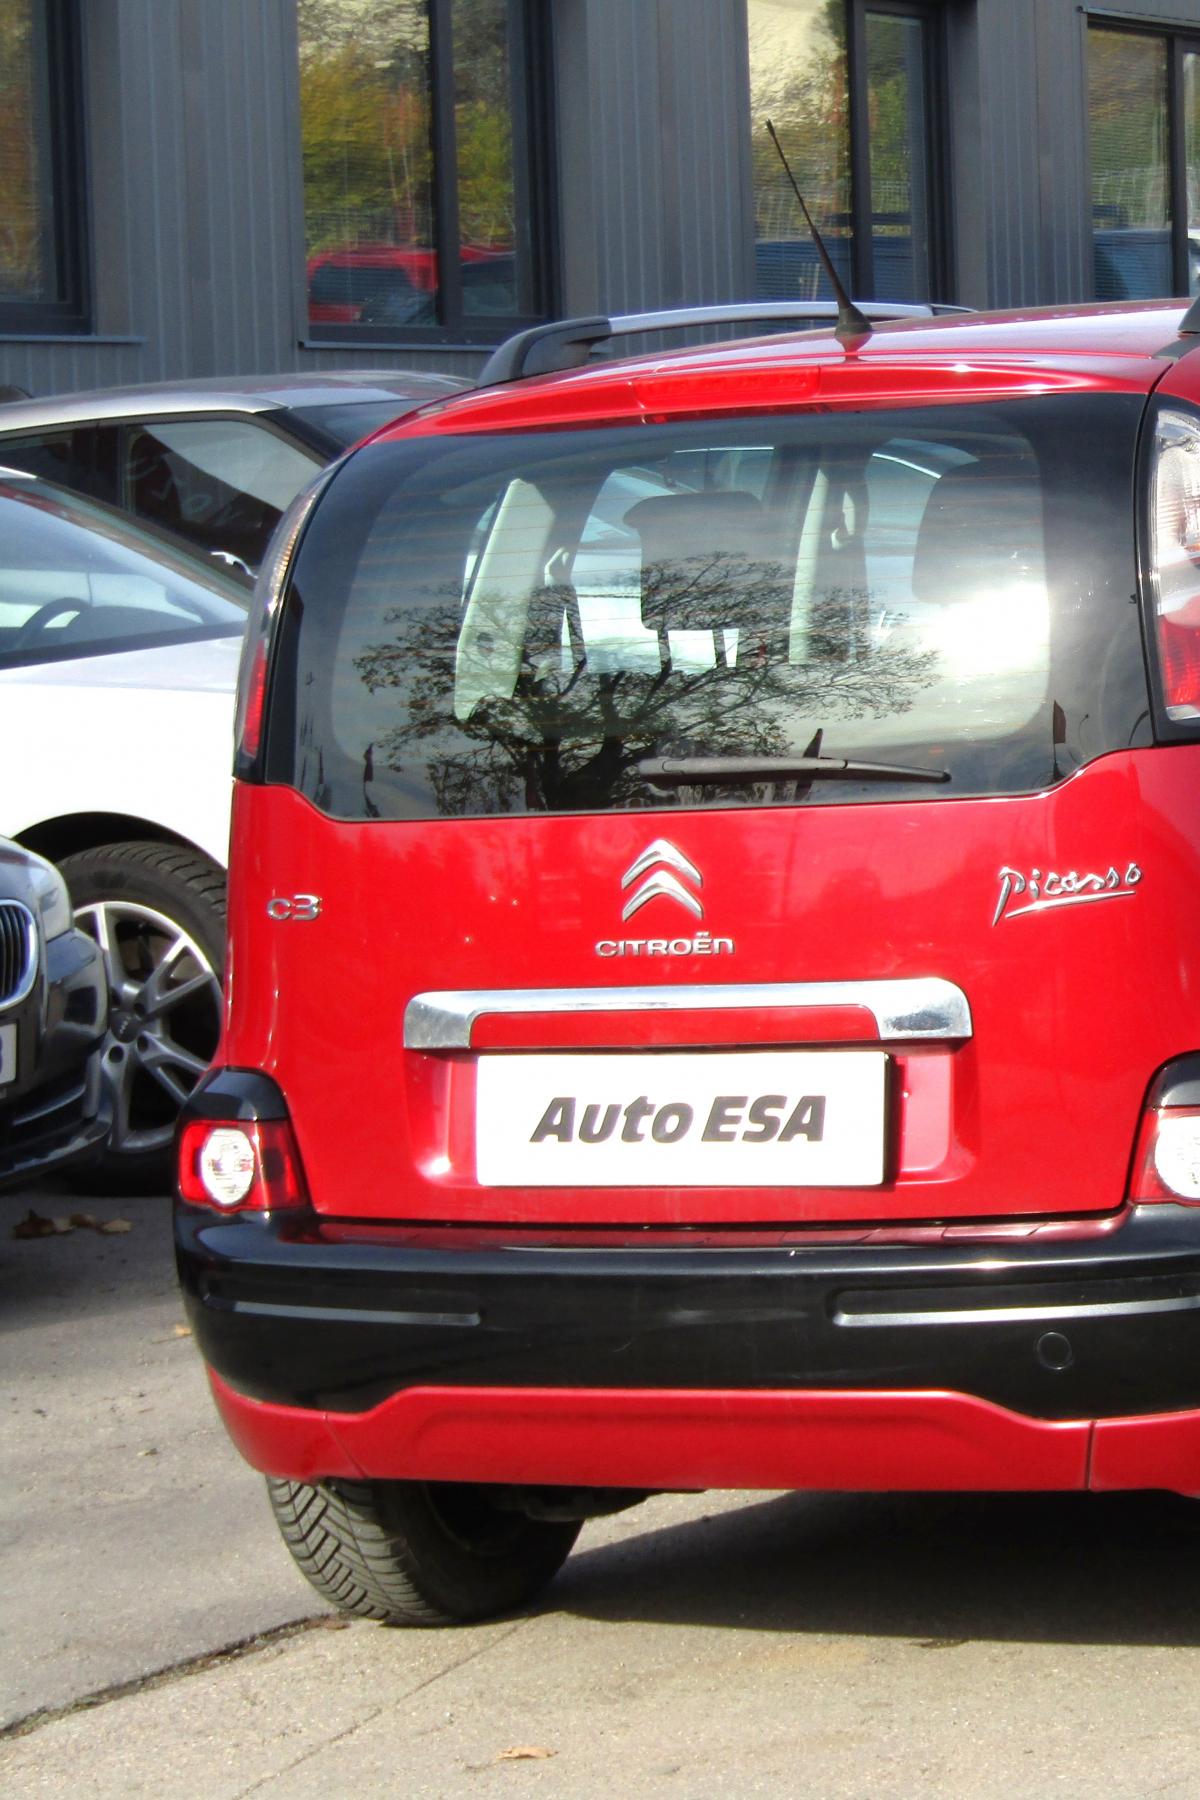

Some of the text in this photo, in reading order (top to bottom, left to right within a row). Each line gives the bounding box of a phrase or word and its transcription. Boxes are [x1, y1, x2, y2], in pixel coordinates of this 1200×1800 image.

[267, 894, 321, 921] C3
[992, 862, 1142, 927] Picasso
[529, 1095, 827, 1143] Auto ESA
